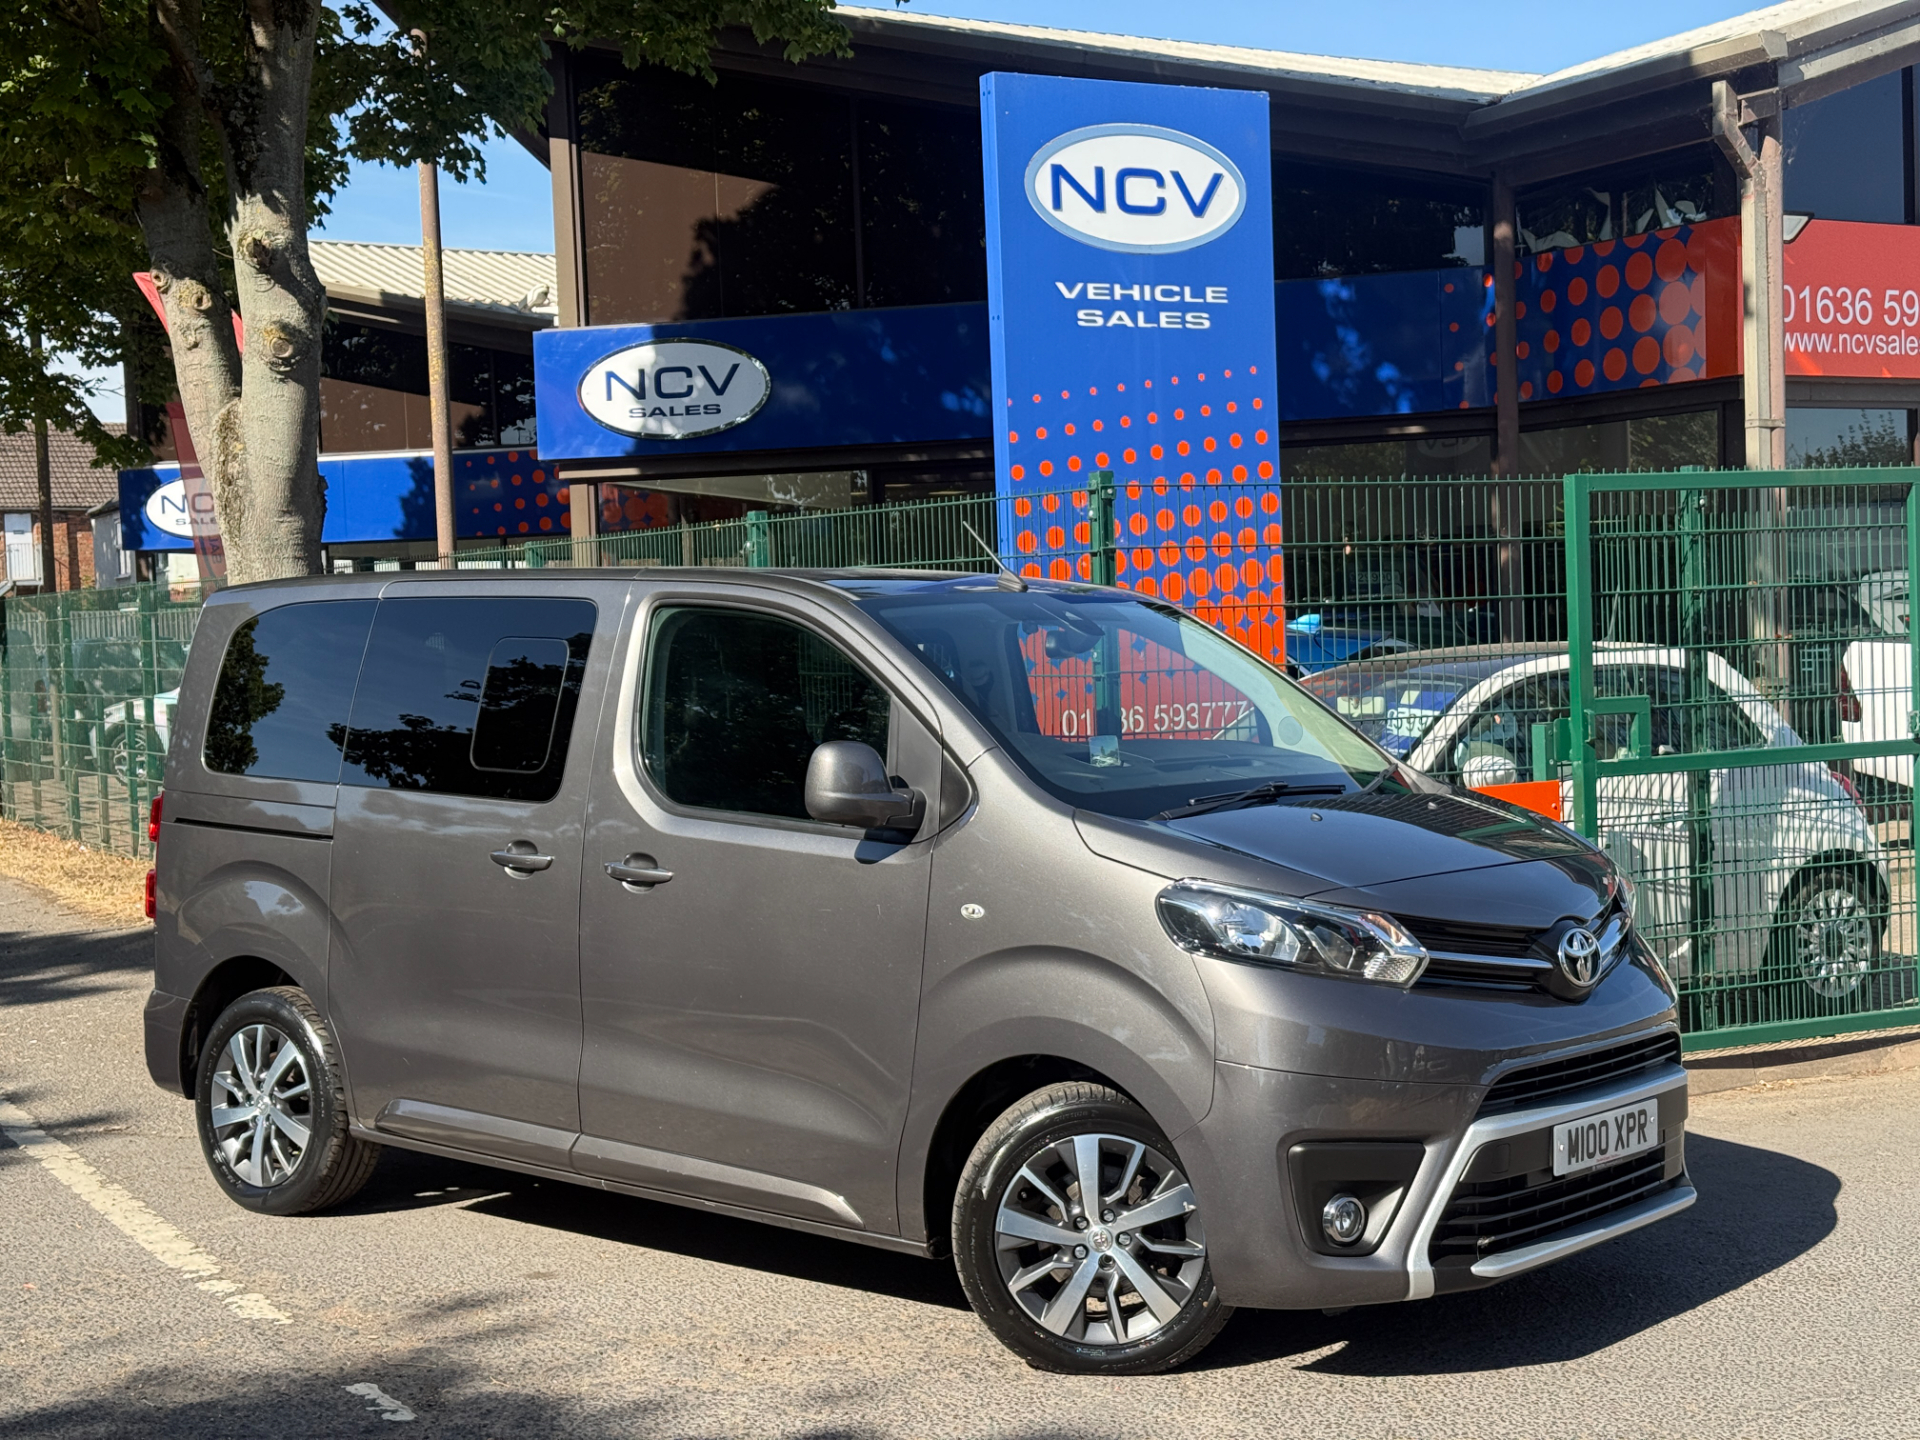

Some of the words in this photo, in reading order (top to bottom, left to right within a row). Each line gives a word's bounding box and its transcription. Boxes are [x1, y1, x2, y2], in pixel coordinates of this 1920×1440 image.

[1050, 163, 1224, 219] NCV
[1055, 281, 1229, 303] VEHICLE
[1783, 284, 1873, 325] 01636
[1076, 309, 1211, 329] SALES
[1783, 329, 1920, 356] www.ncvsale
[605, 363, 741, 402] NCV
[629, 403, 722, 418] SALES
[161, 493, 215, 515] NC
[175, 517, 218, 526] SALE
[1062, 706, 1145, 737] 0136
[1154, 701, 1248, 732] 593777
[1614, 1108, 1648, 1152] XPR
